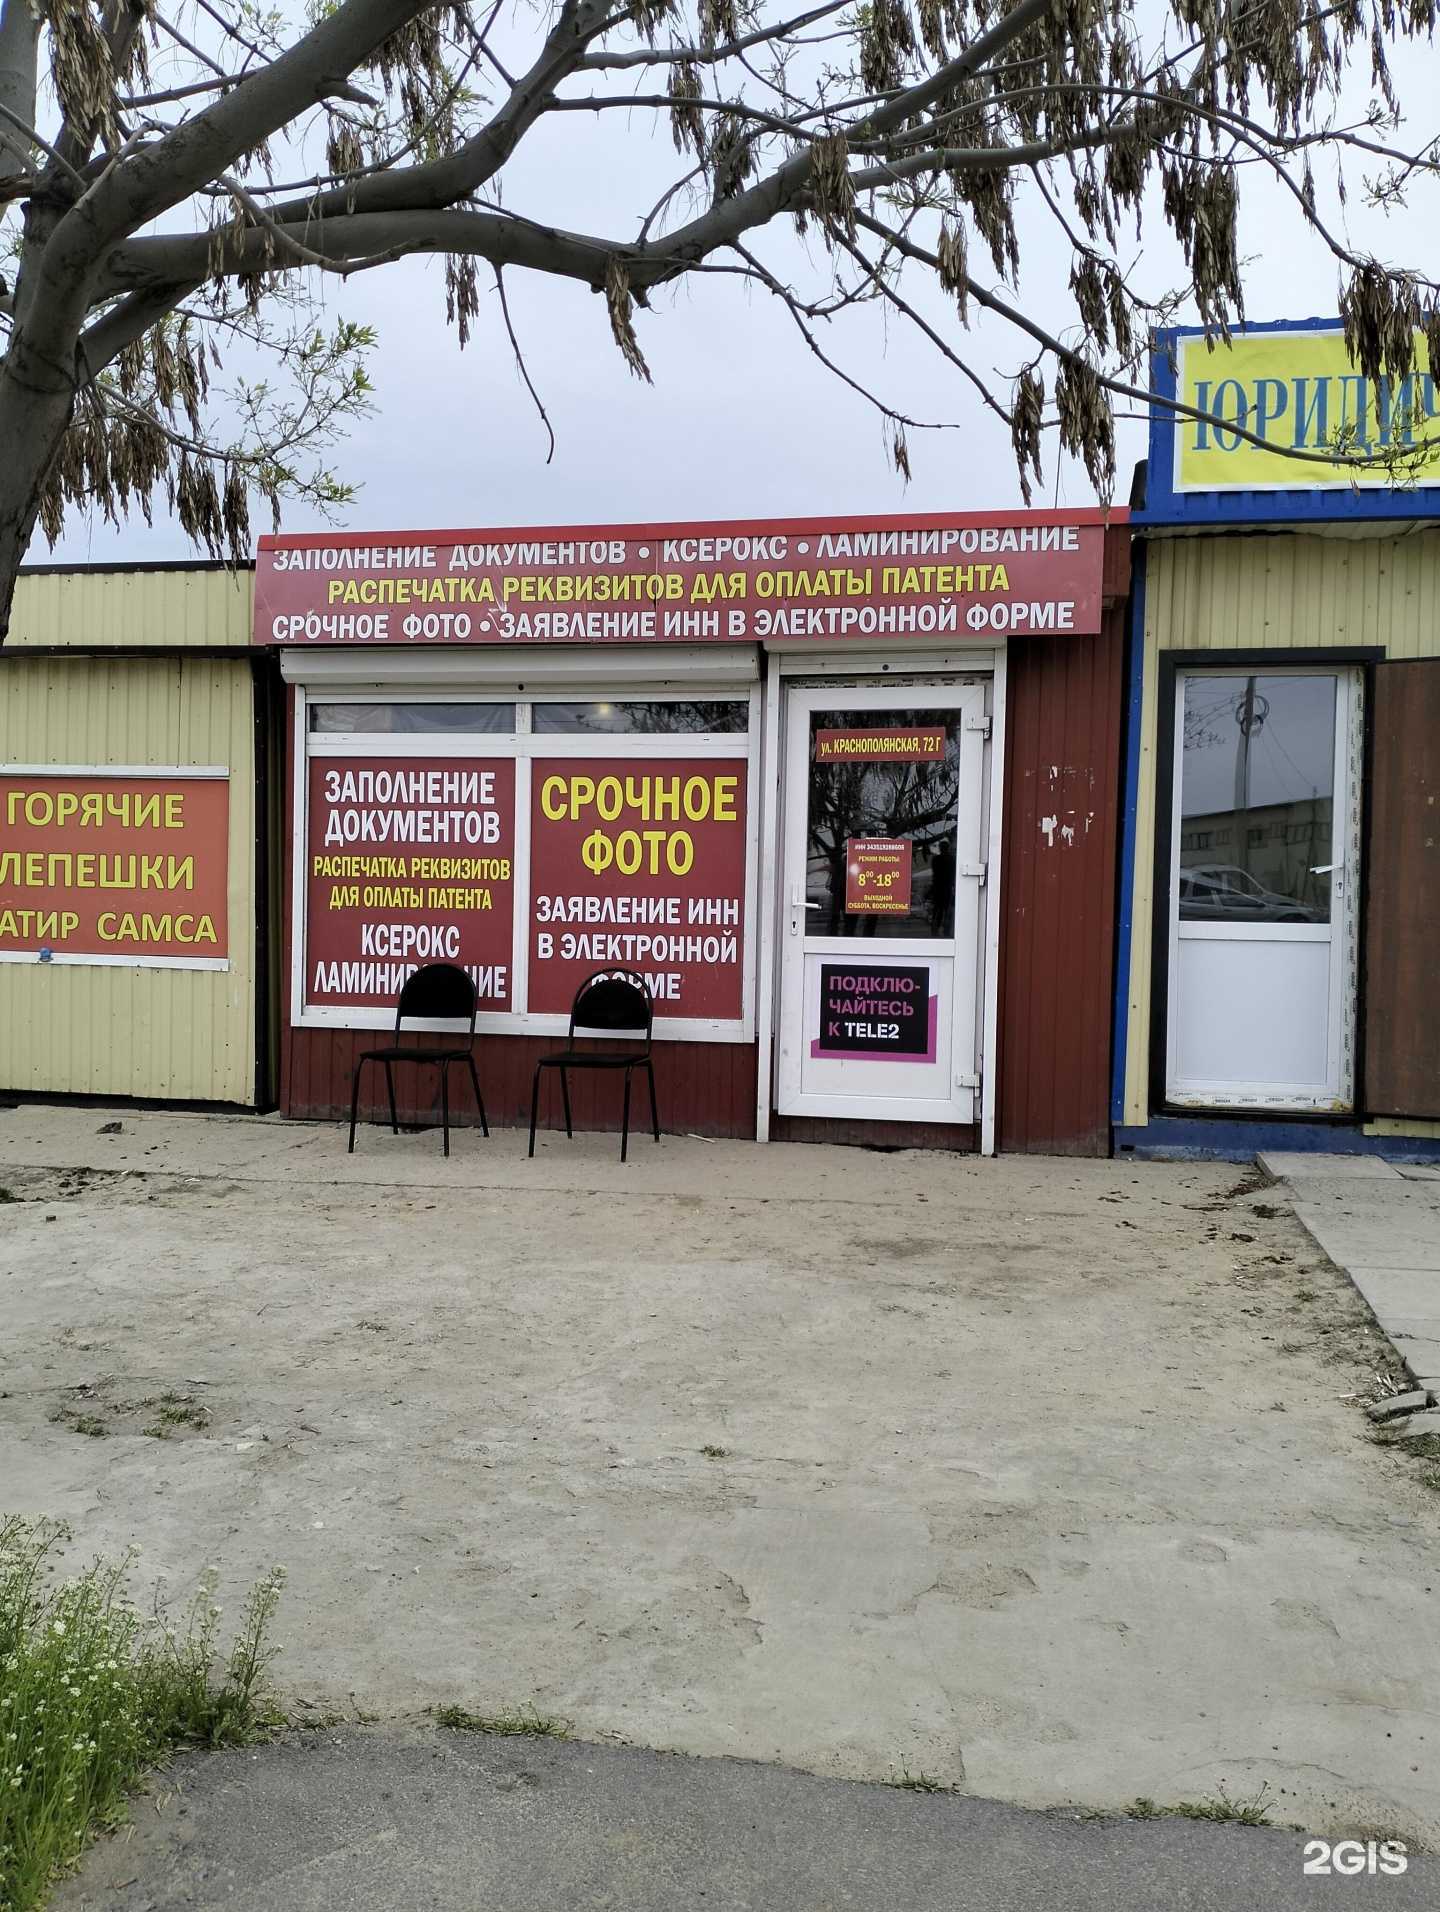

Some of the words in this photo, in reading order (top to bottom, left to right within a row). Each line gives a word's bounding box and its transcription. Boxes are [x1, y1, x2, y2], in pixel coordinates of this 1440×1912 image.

[272, 545, 437, 571] ЗАПОЛНЕНИЕ
[449, 540, 626, 571] ДОКУМЕНТОВ
[663, 536, 788, 563] КСЕРОКС
[816, 526, 1080, 558] ЛАМИНИРОВАНИЕ
[328, 577, 495, 604] РАСПЕЧАТКА
[504, 574, 683, 602] РЕКВИЗИТОВ
[690, 571, 746, 603] ДЛЯ
[755, 569, 871, 598] ОПЛАТЫ
[882, 564, 1009, 594] ПАТЕНТА
[271, 614, 389, 640] СРОЧНОЕ
[402, 612, 472, 640] ФОТО
[499, 610, 656, 639] ЗАЯВЛЕНИЕ
[664, 610, 719, 637] ИНН
[728, 610, 747, 636] В
[754, 597, 957, 636] ЭЛЕКТРОННОЙ
[966, 601, 1075, 631] ФОРМЕ
[821, 742, 832, 757] ул.
[834, 737, 921, 755] КРАСНОПОЛЯНСКАЯ,
[325, 771, 496, 804] ЗАПОЛНЕНИЕ
[541, 776, 738, 821] СРОЧНОЕ
[7, 791, 185, 828] ГОРЯЧИЕ
[325, 809, 500, 847] ДОКУМЕНТОВ
[314, 856, 407, 878] РАСПЕЧАТКА
[411, 857, 511, 880] РЕКВИЗИТОВ
[581, 829, 694, 876] ФОТО
[0, 852, 195, 890] ЛЕПЕШКИ
[329, 886, 359, 910] ДЛЯ
[364, 886, 423, 908] ОПЛАТЫ
[428, 888, 492, 910] ПАТЕНТА
[536, 896, 681, 924] ЗАЯВЛЕНИЕ
[688, 898, 739, 925] ИНН
[97, 912, 218, 943] САМСА
[361, 924, 460, 958] КСЕРОКС
[537, 933, 554, 959] В
[560, 929, 737, 963] ЭЛЕКТРОННОЙ
[314, 961, 507, 998] ЛАМИНИНИЕ
[829, 975, 921, 995] ПОДКЛЮ-
[829, 996, 914, 1016] ЧАЙТЕСЬ
[828, 1021, 840, 1037] К
[845, 1022, 900, 1039] TELE2
